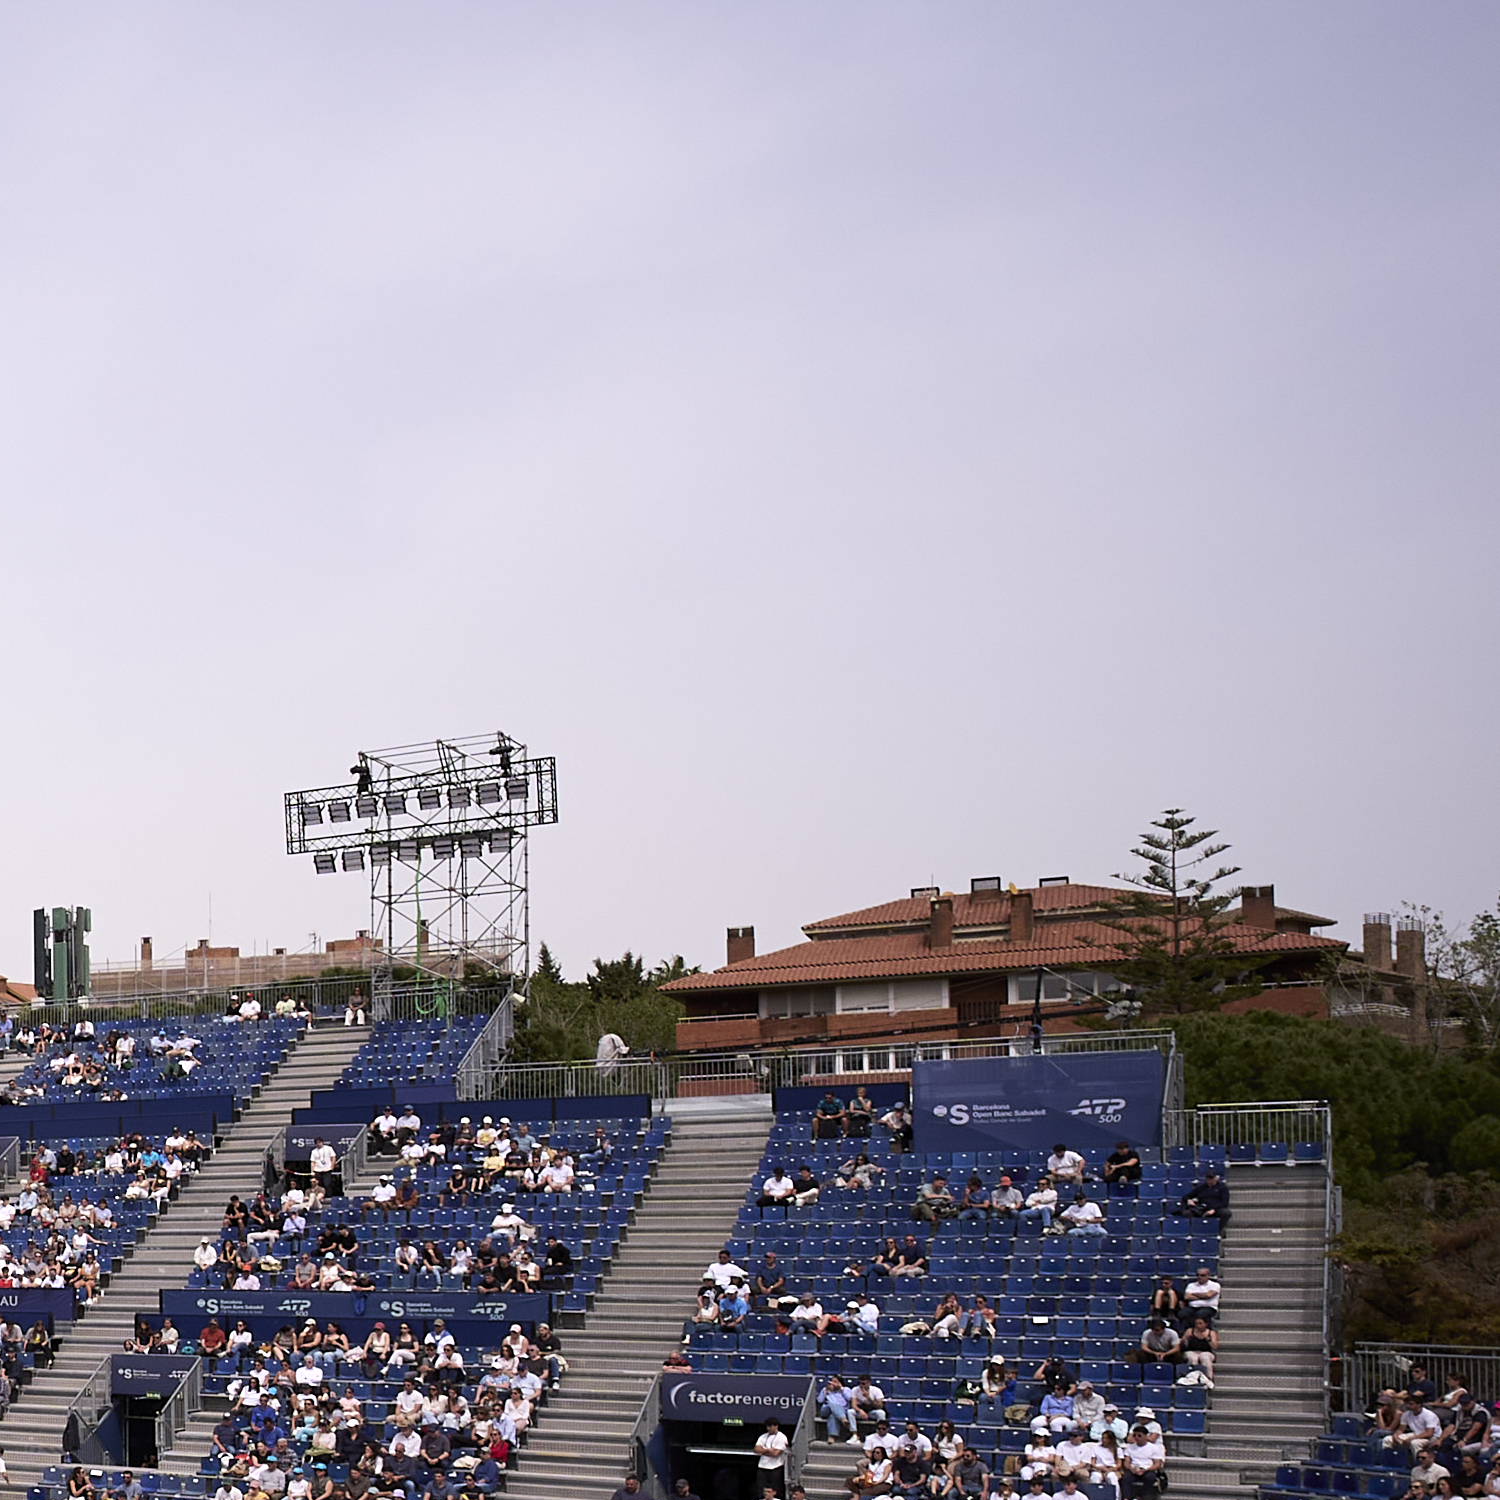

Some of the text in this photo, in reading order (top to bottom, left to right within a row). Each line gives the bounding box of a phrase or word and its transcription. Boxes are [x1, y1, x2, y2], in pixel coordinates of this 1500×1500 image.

[1067, 1099, 1126, 1115] ATP
[1014, 1109, 1046, 1117] Sabadell
[1098, 1114, 1122, 1124] 500
[275, 1300, 312, 1311] ATP
[468, 1302, 508, 1314] ATP
[489, 1313, 505, 1321] 500
[689, 1390, 805, 1409] factorenergia
